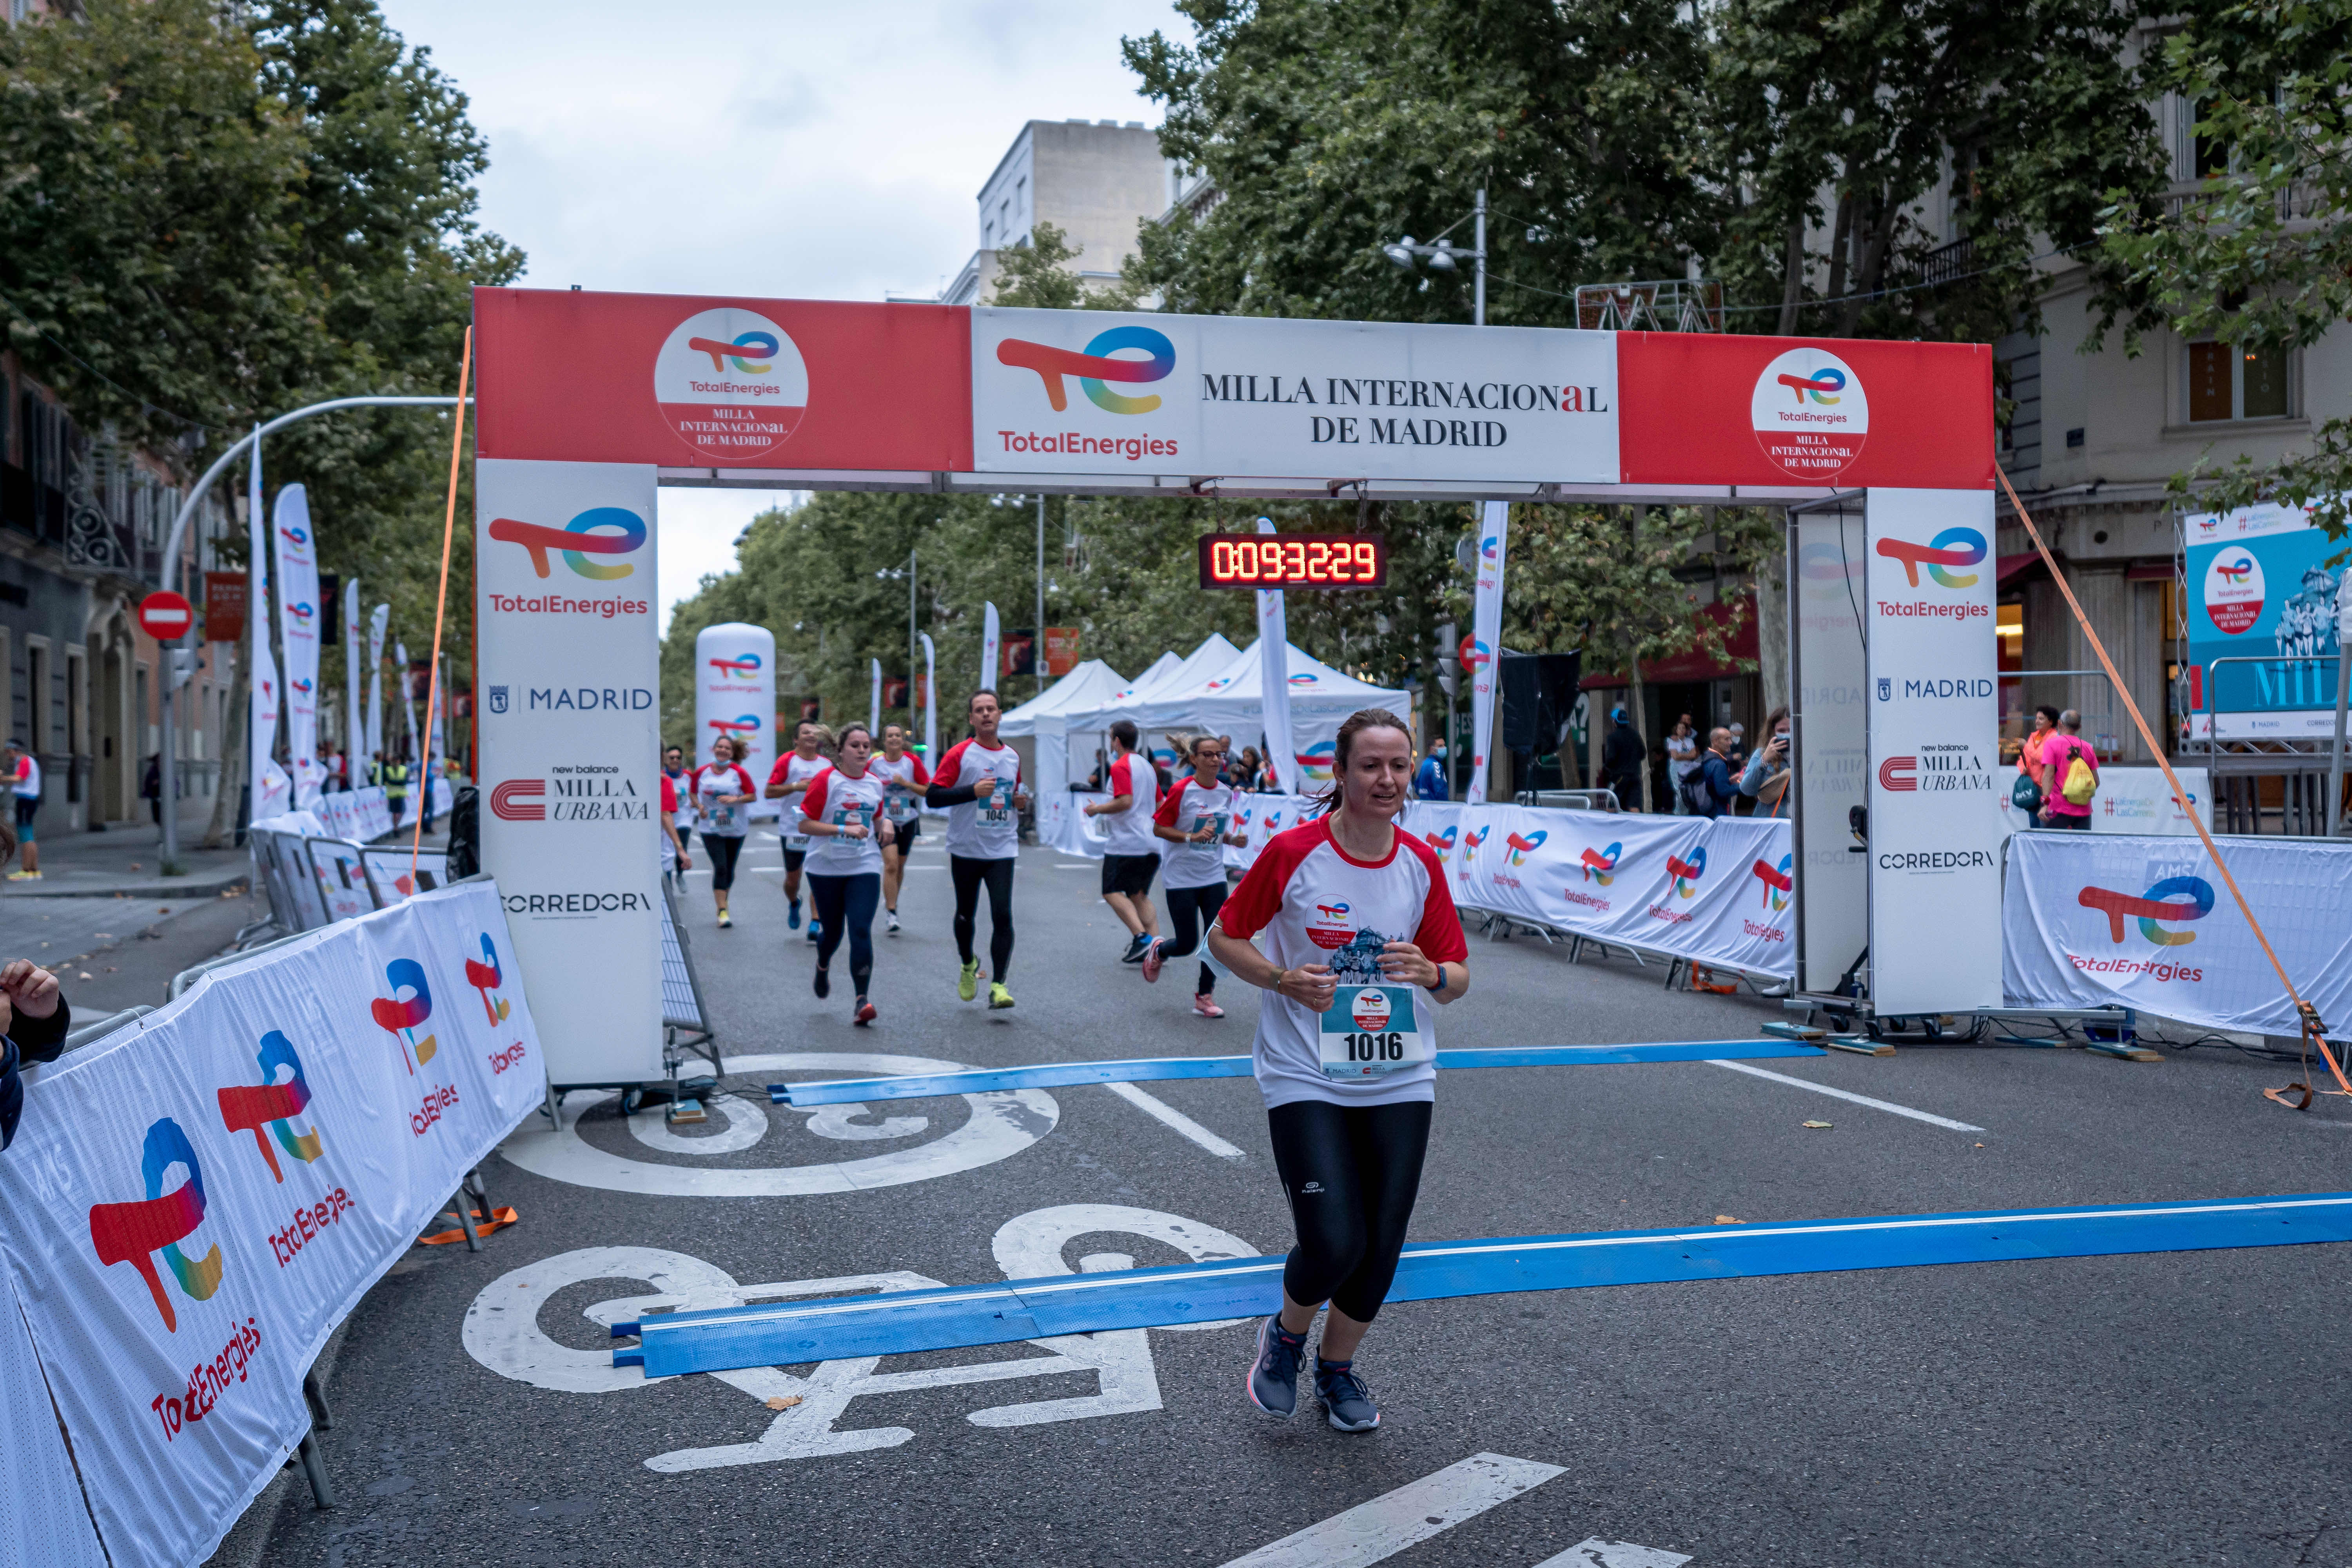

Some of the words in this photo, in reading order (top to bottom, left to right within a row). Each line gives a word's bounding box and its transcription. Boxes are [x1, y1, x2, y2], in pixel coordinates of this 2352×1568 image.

[690, 381, 780, 396] TotalEnergies
[1201, 373, 1316, 404] MILLA
[713, 408, 755, 420] MILLA
[1778, 411, 1847, 425] TotalEnergies
[697, 434, 717, 445] DE
[719, 435, 772, 446] MADRID
[1310, 416, 1360, 445] DE
[1370, 417, 1508, 448] MADRID
[1796, 434, 1829, 445] MILLA
[998, 430, 1178, 461] TotalEnergies
[1784, 457, 1798, 467] DE
[1800, 457, 1841, 468] MADRID
[2218, 589, 2254, 597] TotalEnergies
[488, 594, 648, 618] TotalEnergies
[1877, 601, 1989, 621] TotalEnergies
[2230, 619, 2251, 627] MADRID
[1906, 679, 1993, 698] MADRID
[530, 688, 652, 710] MADRID
[1938, 744, 1969, 752] balance
[576, 765, 619, 774] balance
[1922, 755, 1982, 771] MILLA
[554, 779, 637, 797] MILLA
[1923, 774, 1992, 791] URBANA
[554, 801, 650, 820] URBANA
[986, 809, 1007, 821] 1043
[1564, 888, 1611, 912] TotalEnergies
[1344, 1032, 1403, 1062] 1016
